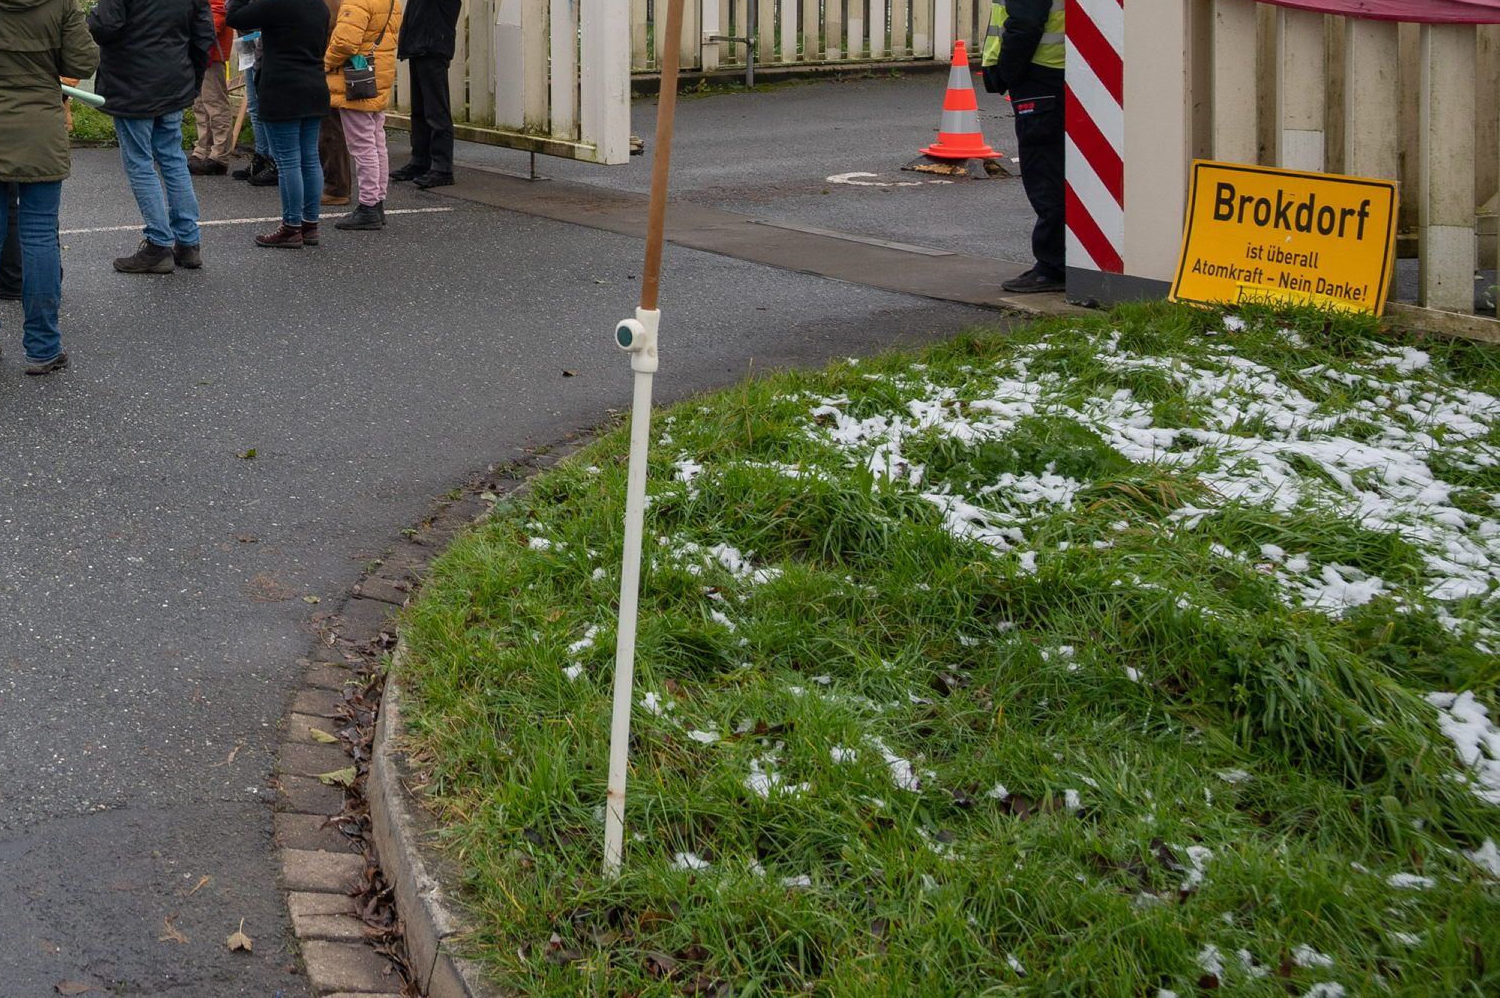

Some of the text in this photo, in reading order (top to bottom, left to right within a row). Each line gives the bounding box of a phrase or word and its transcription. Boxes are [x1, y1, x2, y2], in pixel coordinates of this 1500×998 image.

[1213, 182, 1371, 240] Brokdorf
[1245, 242, 1319, 269] ist überall
[1191, 258, 1263, 284] Atomkraft
[1278, 271, 1311, 292] Nein
[1315, 277, 1368, 302] Danke!
